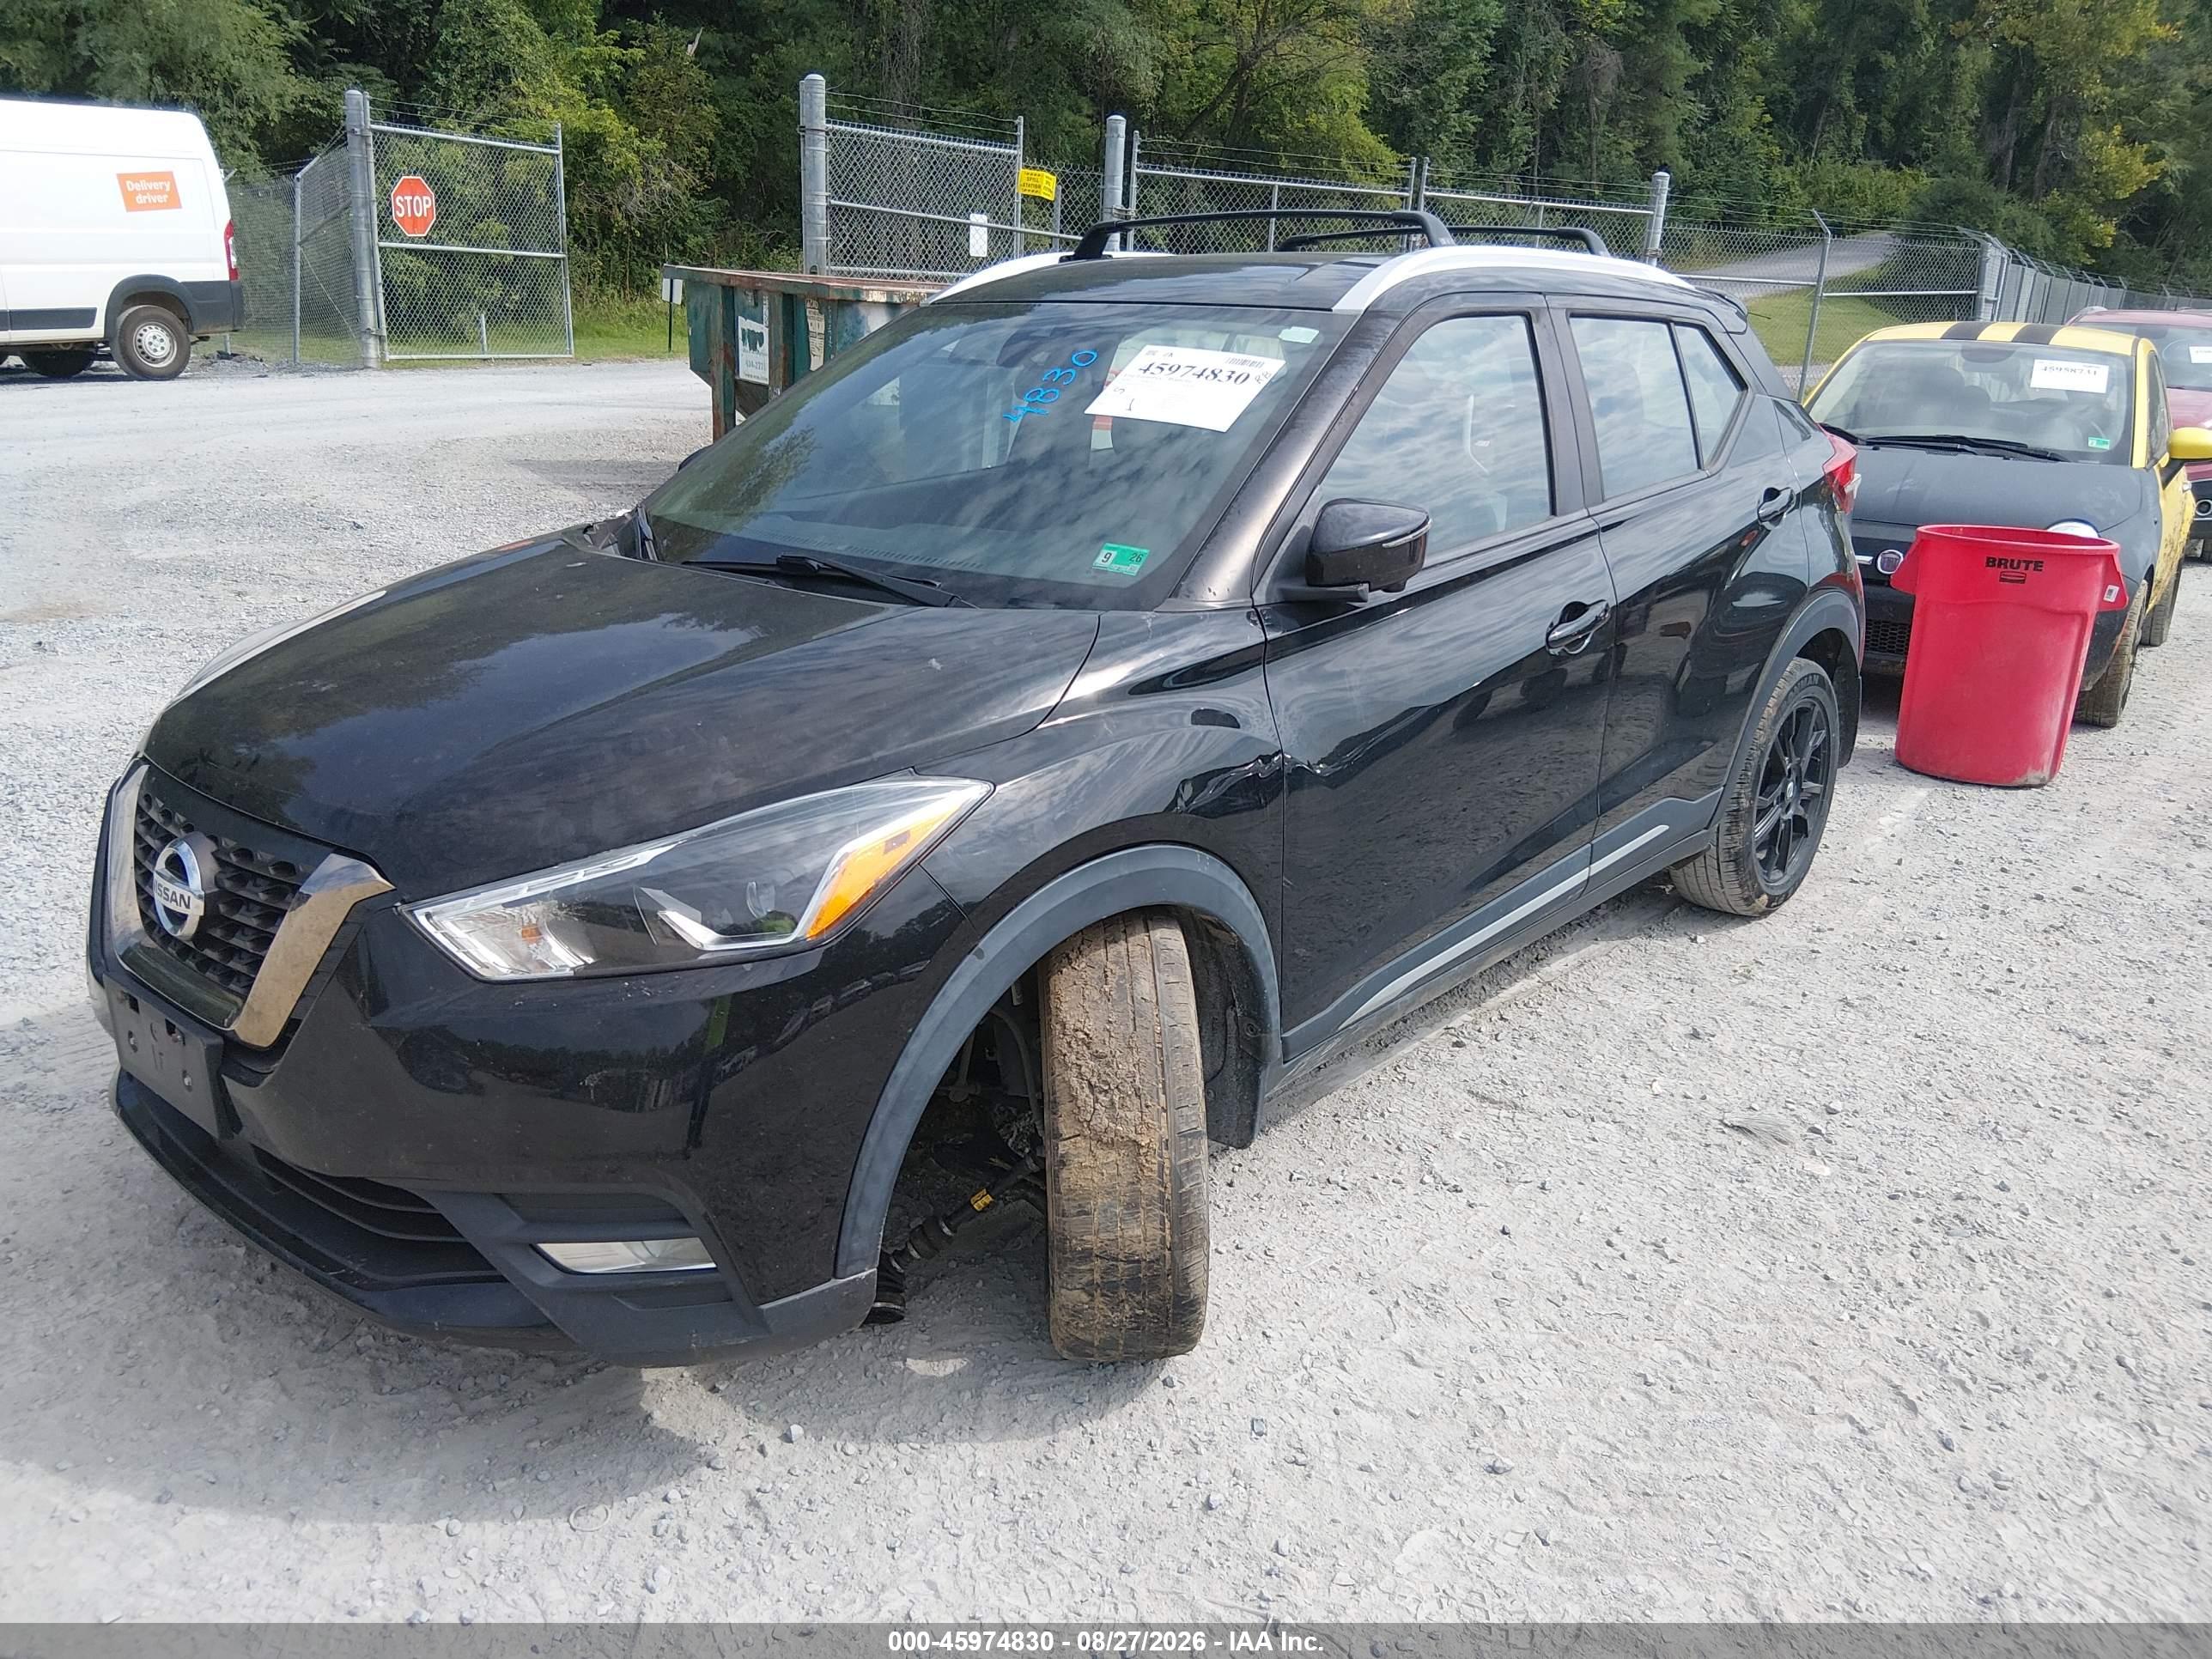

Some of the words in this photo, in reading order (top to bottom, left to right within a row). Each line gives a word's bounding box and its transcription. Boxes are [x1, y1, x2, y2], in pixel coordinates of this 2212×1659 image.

[125, 179, 171, 192] Delivery
[135, 192, 169, 204] driver
[395, 195, 432, 218] STOP
[1139, 362, 1250, 386] 45974830
[1002, 349, 1098, 422] 4830
[1102, 552, 1113, 563] 9
[1129, 552, 1143, 563] 26
[1984, 556, 2045, 572] BRUTE
[155, 878, 191, 909] ISSAN
